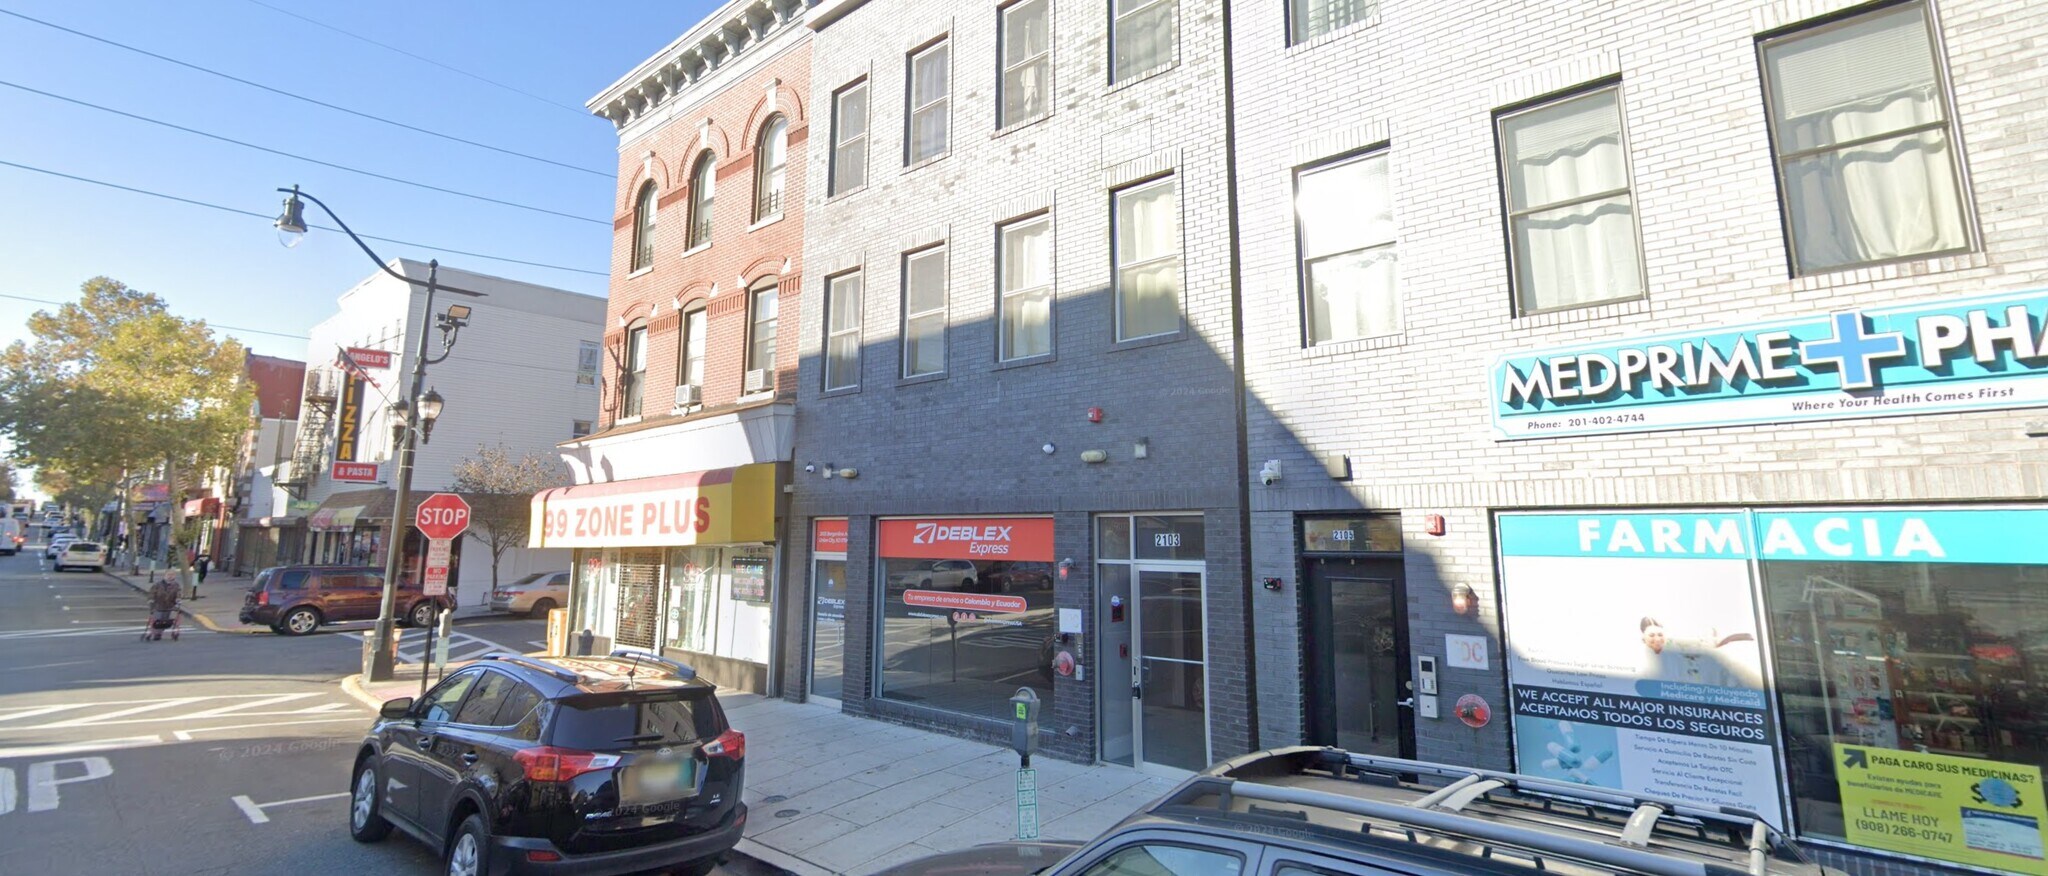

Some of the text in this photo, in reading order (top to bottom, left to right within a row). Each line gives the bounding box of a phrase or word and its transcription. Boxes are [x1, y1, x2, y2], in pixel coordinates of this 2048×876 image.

[1917, 305, 2048, 366] PH
[1502, 331, 1796, 403] MEDPRIME
[1792, 387, 2014, 411] Where Your Health Comes First
[340, 371, 358, 460] IZZA
[1528, 413, 1645, 430] Phone: 201-402-4744
[346, 468, 372, 477] PASTA
[420, 508, 466, 526] STOP
[545, 496, 710, 538] 99 ZONE PLUS
[936, 526, 1012, 542] DEBLEX
[1156, 534, 1180, 546] 2103
[1577, 517, 1947, 557] FARMACIA
[969, 542, 1008, 556] Express
[964, 597, 990, 606] Colombia
[996, 600, 1021, 608] Ecuador
[1518, 689, 1762, 725] WE ACCEPT ALL MAJOR INSURANCES
[1661, 691, 1704, 702] Medicare
[1716, 696, 1760, 706] Medicaid
[1520, 702, 1764, 740] ACEPTAMOS TODOS LOS SEGUROS
[1872, 755, 2035, 784] PAGA CARO SUS MEDICINAS?
[1863, 806, 1939, 827] LLAME HOY
[1856, 818, 1890, 834] (908)
[1892, 825, 1952, 843] 266-0747
